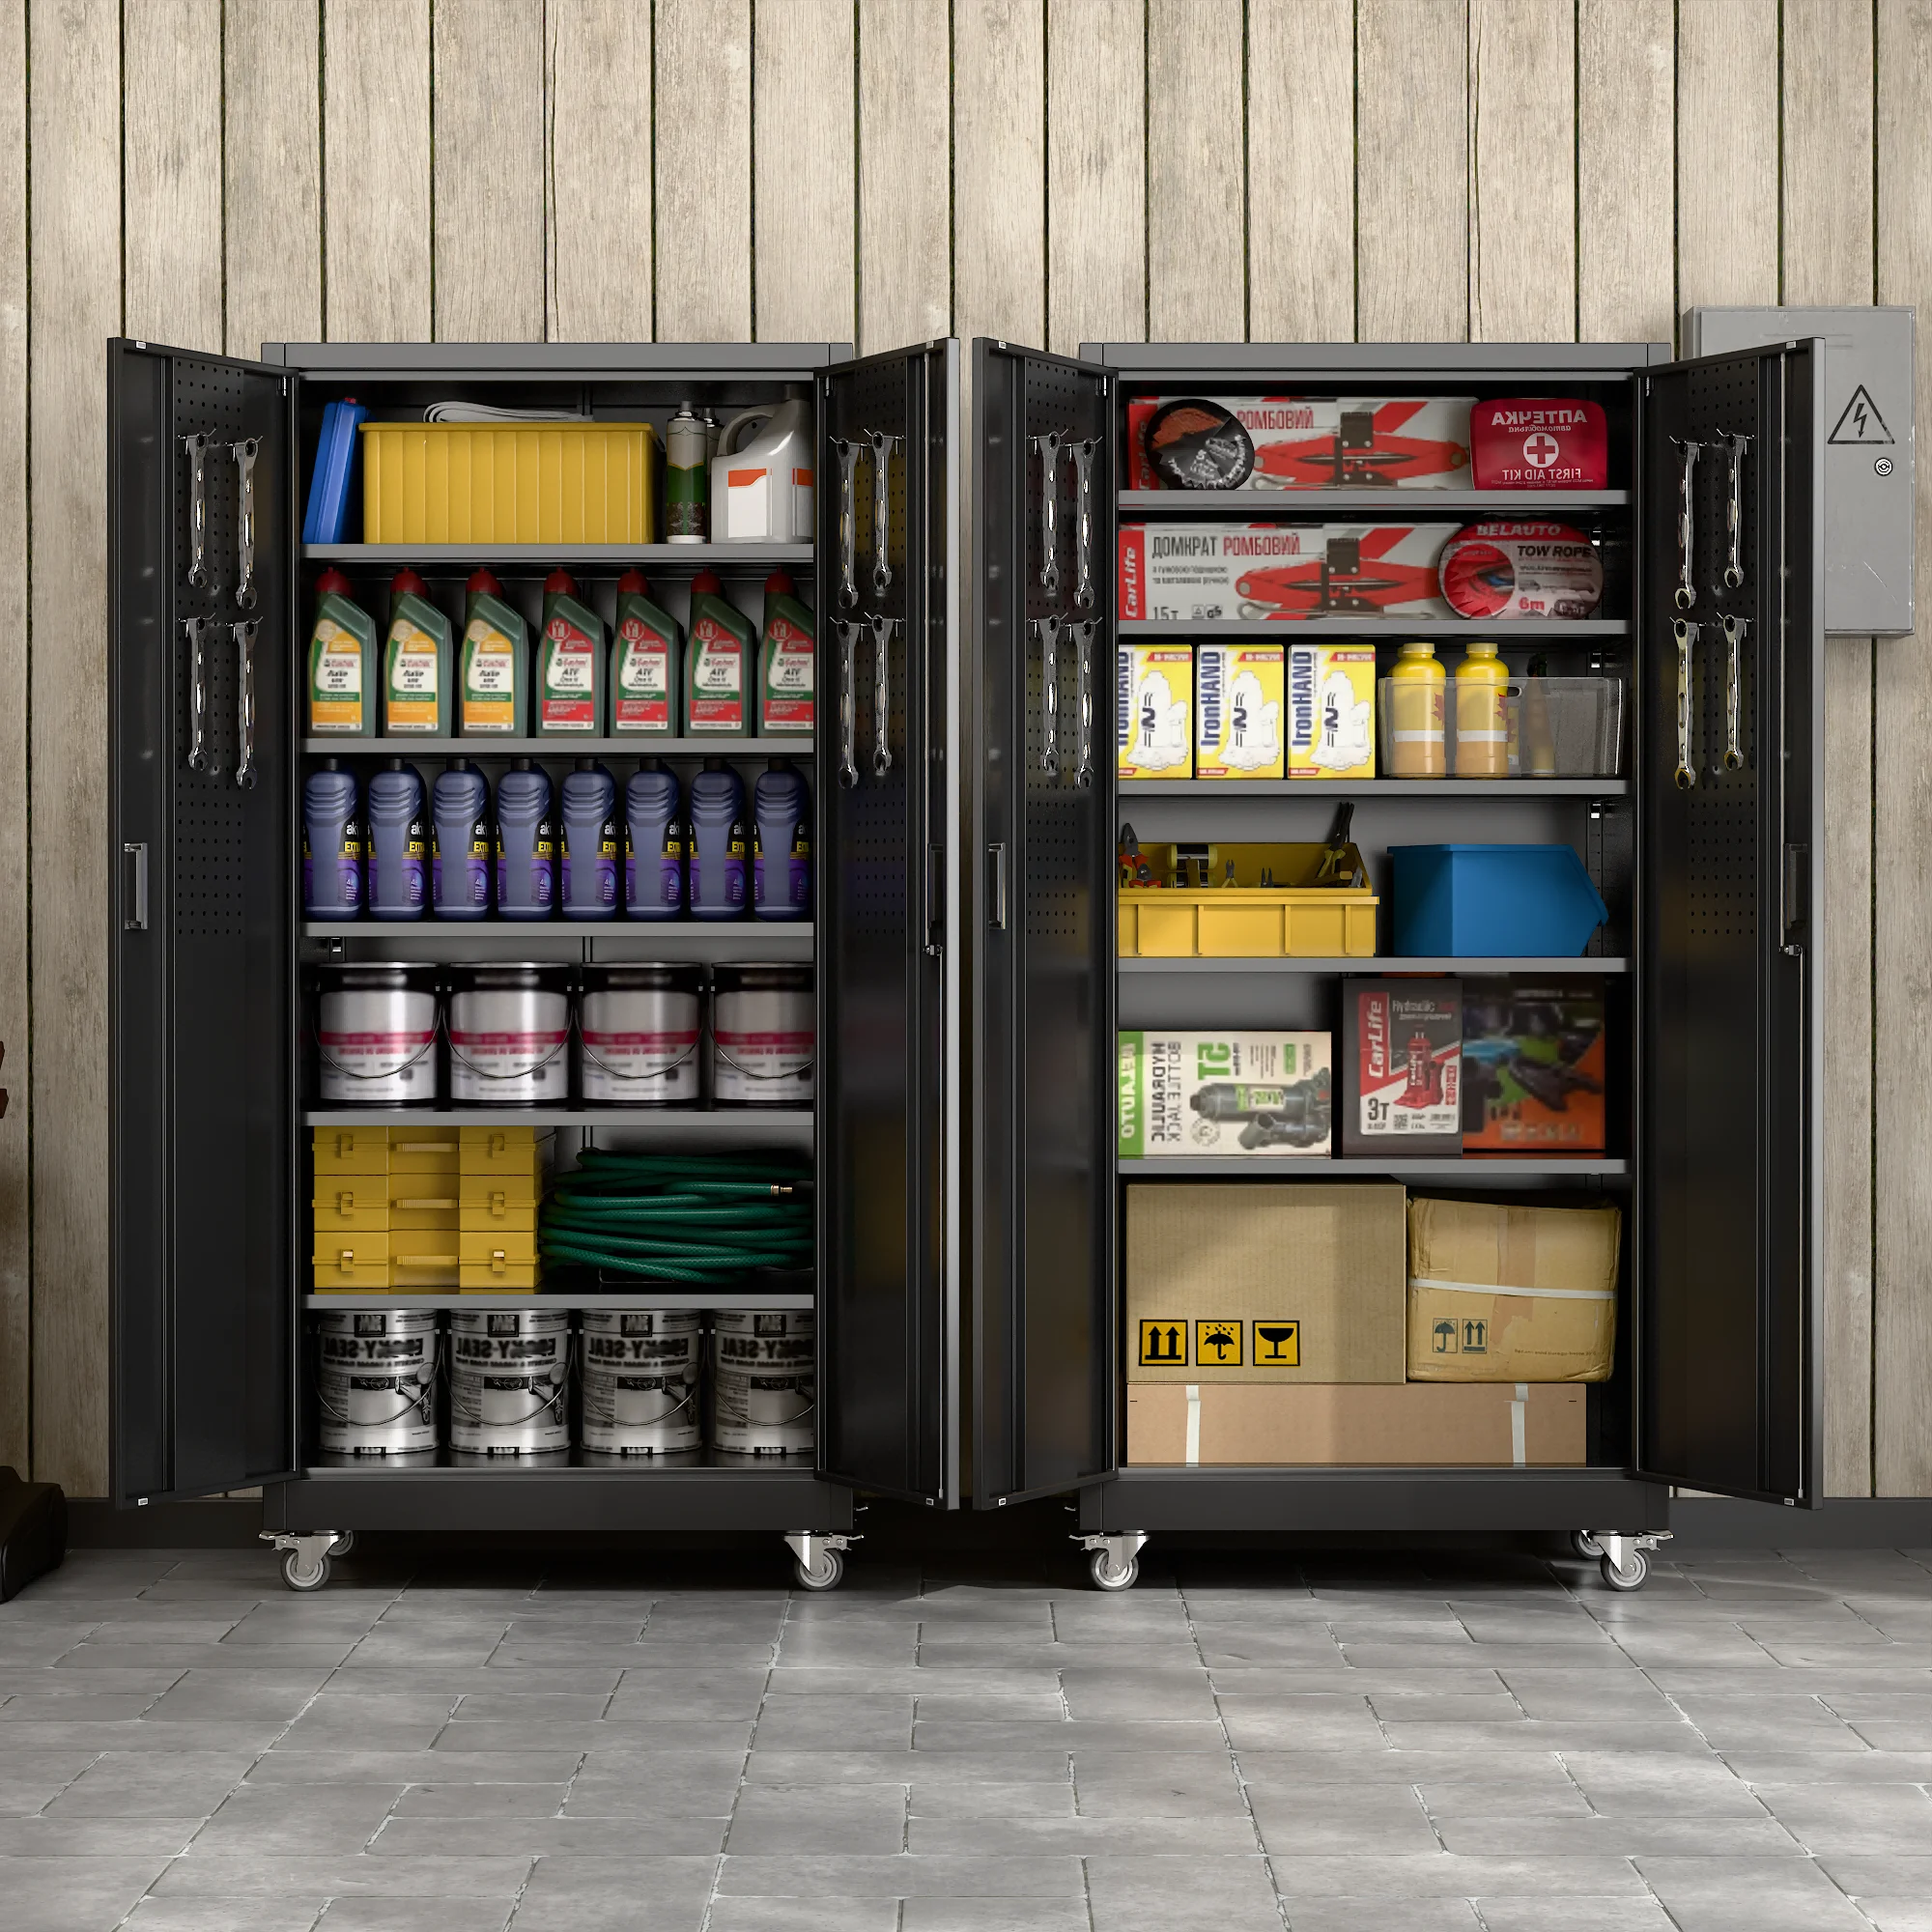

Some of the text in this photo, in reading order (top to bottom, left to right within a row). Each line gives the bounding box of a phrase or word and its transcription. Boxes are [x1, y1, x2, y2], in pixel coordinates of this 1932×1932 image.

[1237, 406, 1314, 430] РОМБОВИЙ
[1476, 524, 1562, 537] BELAUTO
[1151, 531, 1301, 559] ДОМКРАТ РОМБОВИЙ
[1517, 545, 1593, 557] TOW ROPE
[1124, 546, 1138, 618] CarLife
[1519, 597, 1545, 611] 6m
[1201, 651, 1221, 747] IronHAND
[1292, 651, 1313, 747] IronHAND
[1367, 1000, 1383, 1078] CarLife
